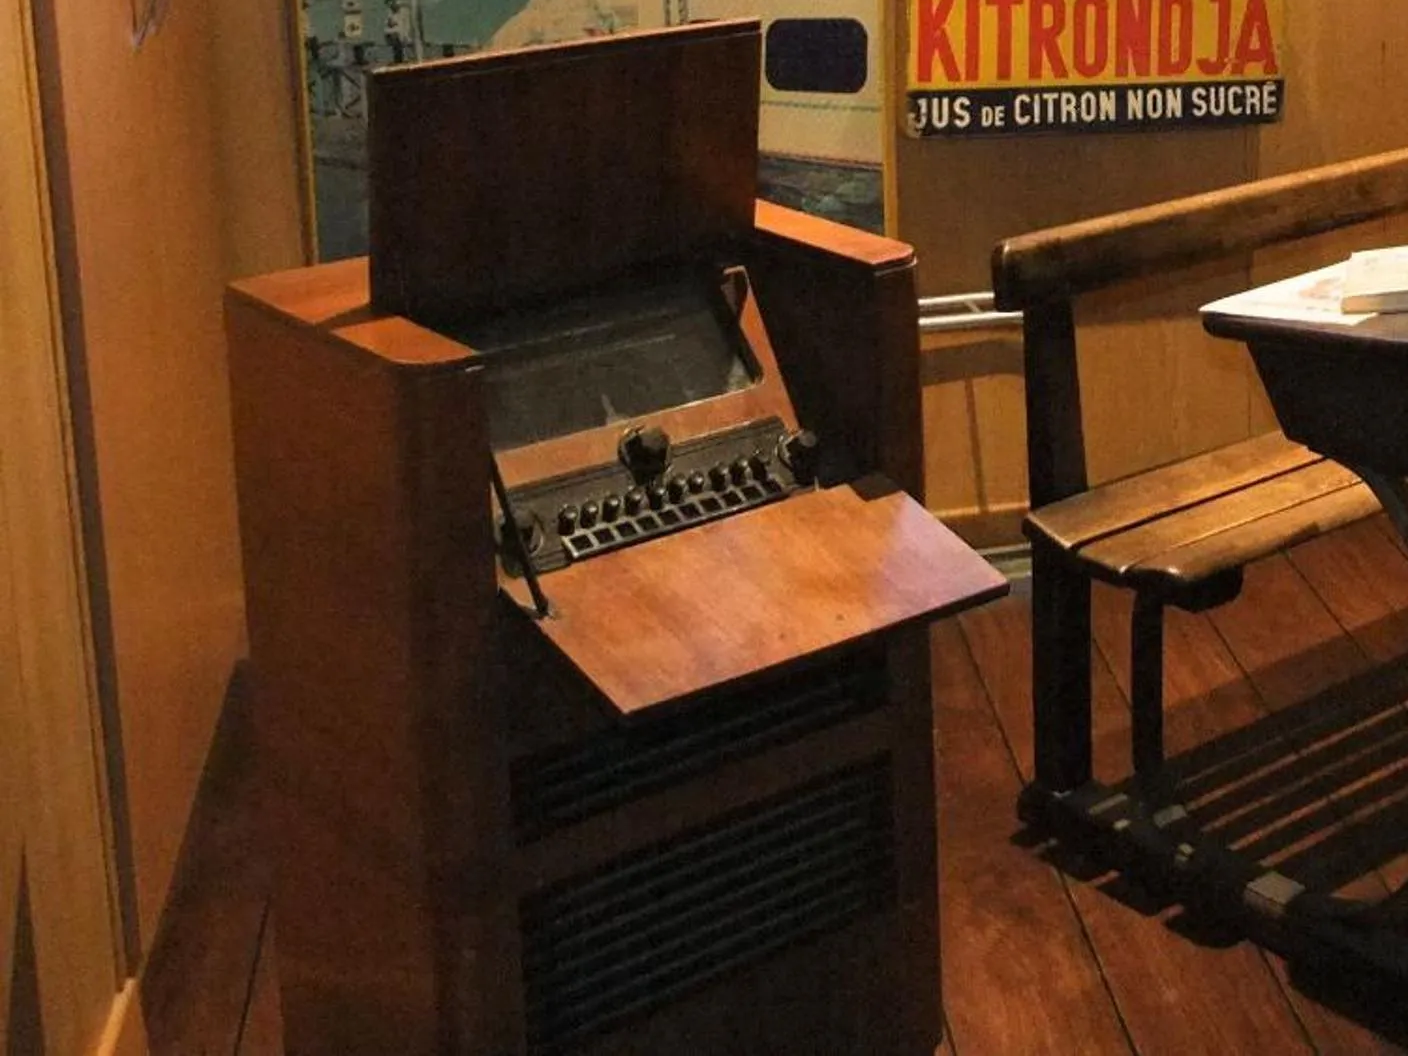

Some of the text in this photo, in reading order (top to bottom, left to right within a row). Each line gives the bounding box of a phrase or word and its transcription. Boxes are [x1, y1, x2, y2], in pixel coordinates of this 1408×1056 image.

[911, 96, 971, 130] JUS
[1014, 91, 1116, 125] CITRON
[1127, 87, 1184, 121] NON
